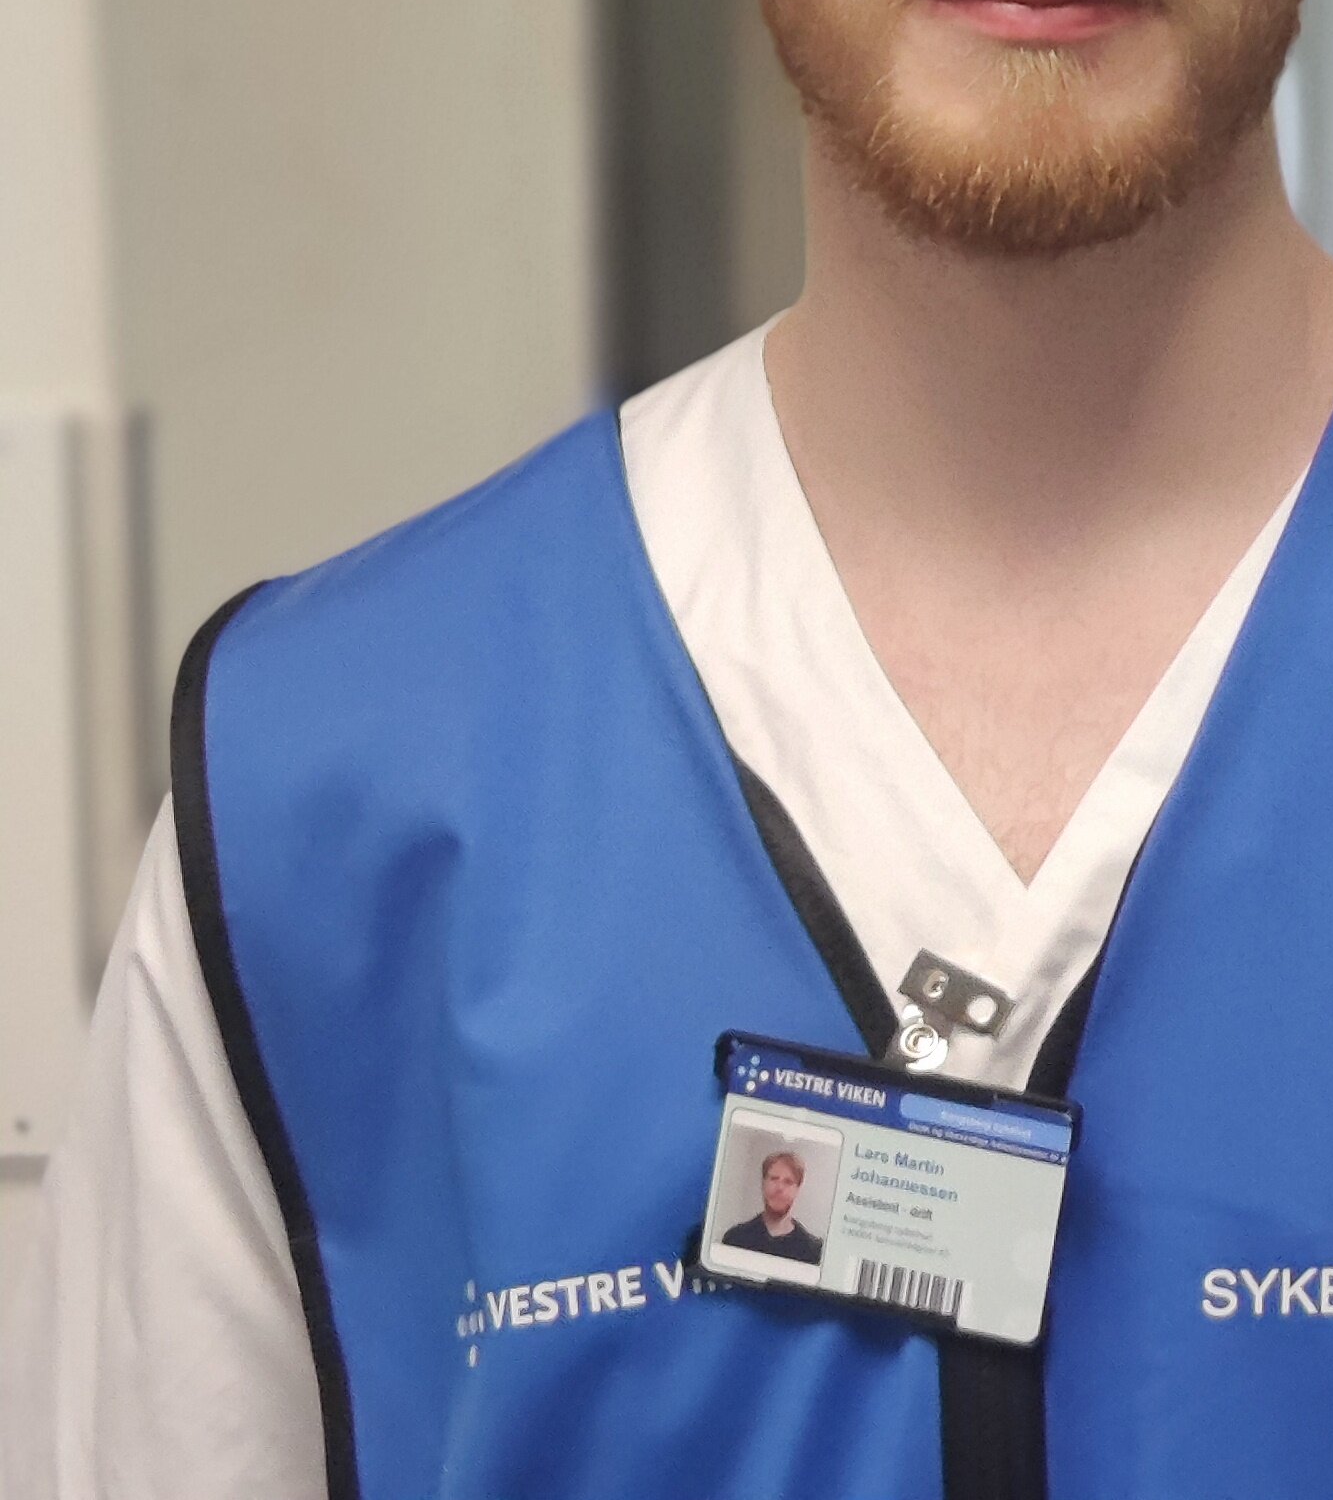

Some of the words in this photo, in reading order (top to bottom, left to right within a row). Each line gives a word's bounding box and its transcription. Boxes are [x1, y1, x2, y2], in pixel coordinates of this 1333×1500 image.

[774, 1067, 834, 1097] VESTRE
[836, 1081, 886, 1109] VIKEN
[854, 1143, 889, 1164] Lars
[894, 1152, 945, 1176] Martin
[487, 1265, 646, 1330] VESTRE
